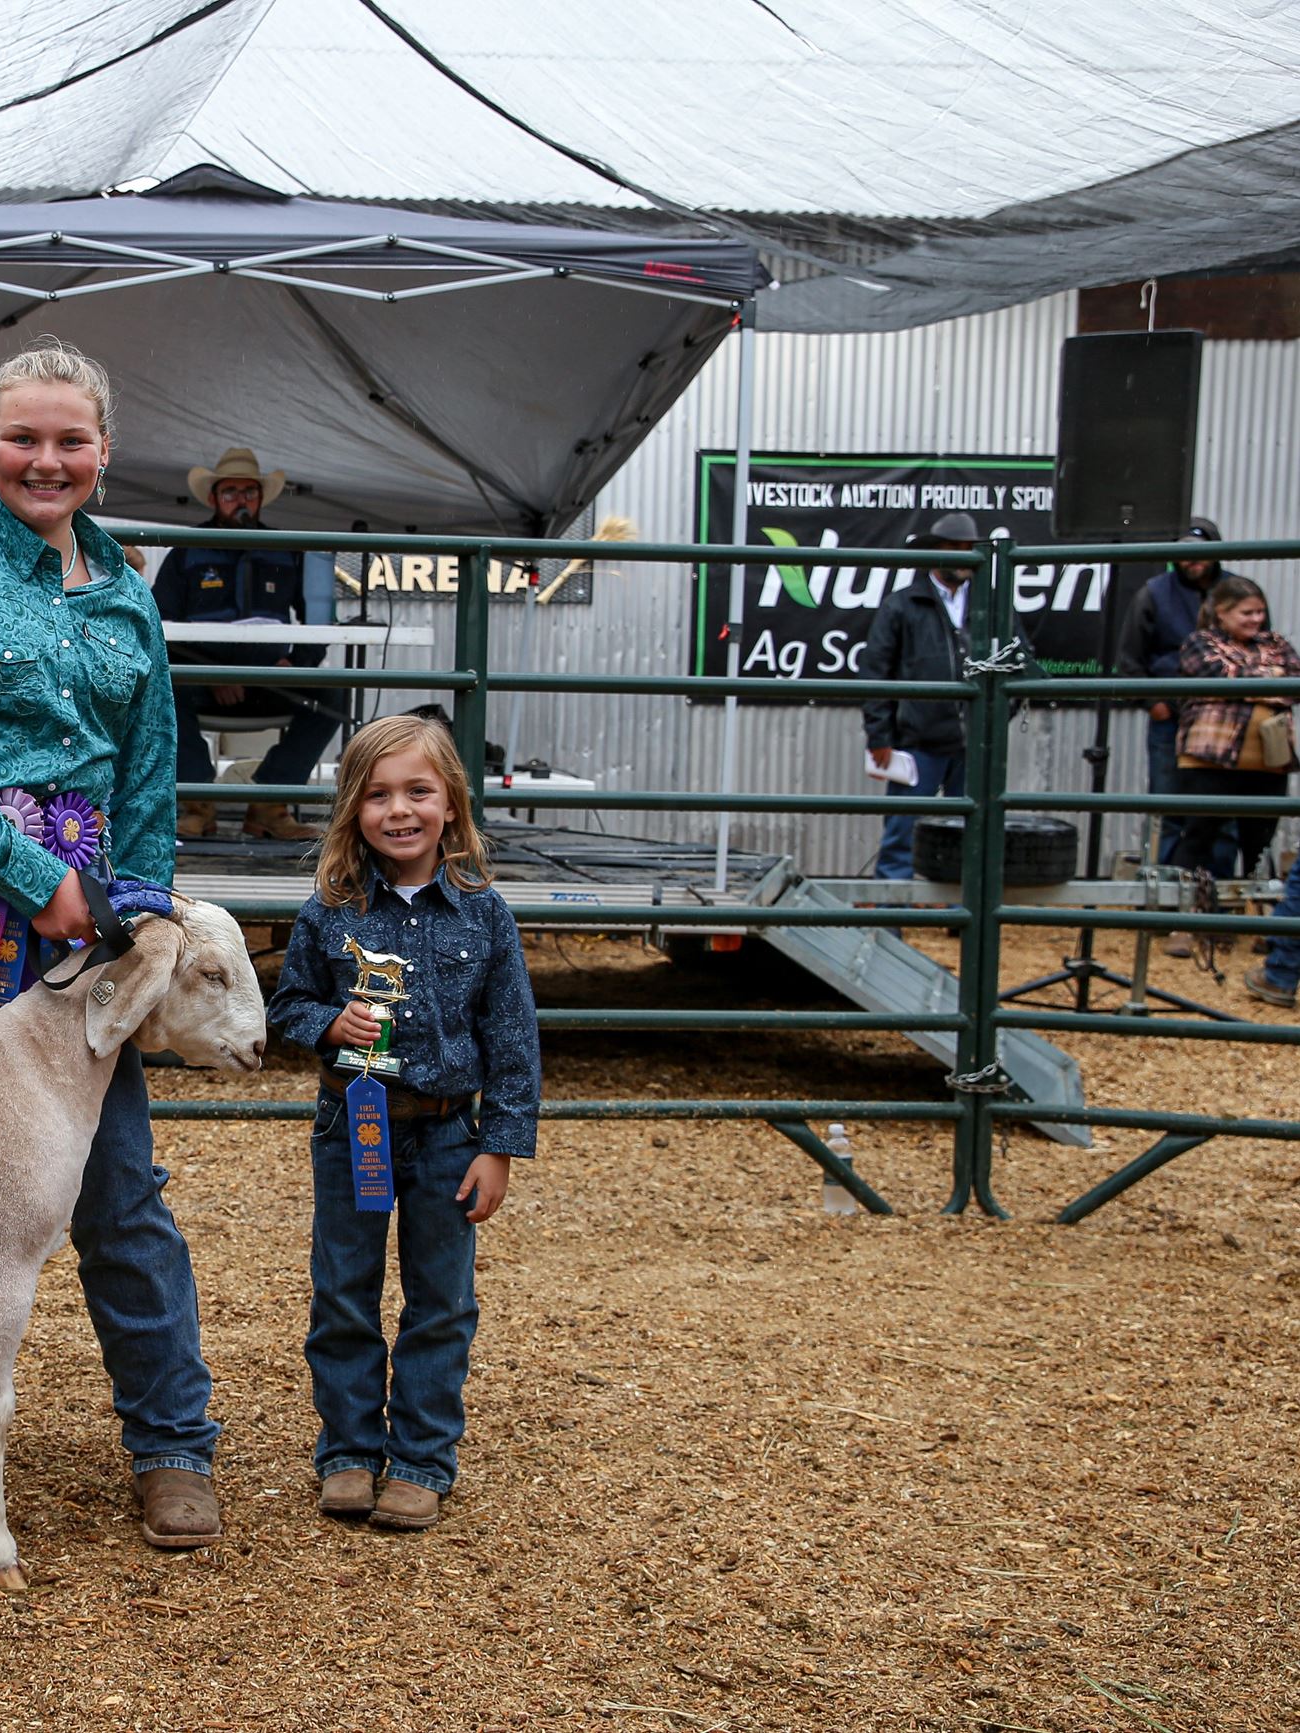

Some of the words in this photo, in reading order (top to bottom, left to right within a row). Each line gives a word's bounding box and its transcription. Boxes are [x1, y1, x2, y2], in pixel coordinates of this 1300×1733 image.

[746, 481, 834, 507] IVESTOCK
[840, 483, 916, 509] AUCTION
[920, 485, 1007, 510] PROUDLY
[742, 629, 807, 679] Ag
[355, 1112, 381, 1120] PREMIUM
[360, 1104, 376, 1112] FIRST
